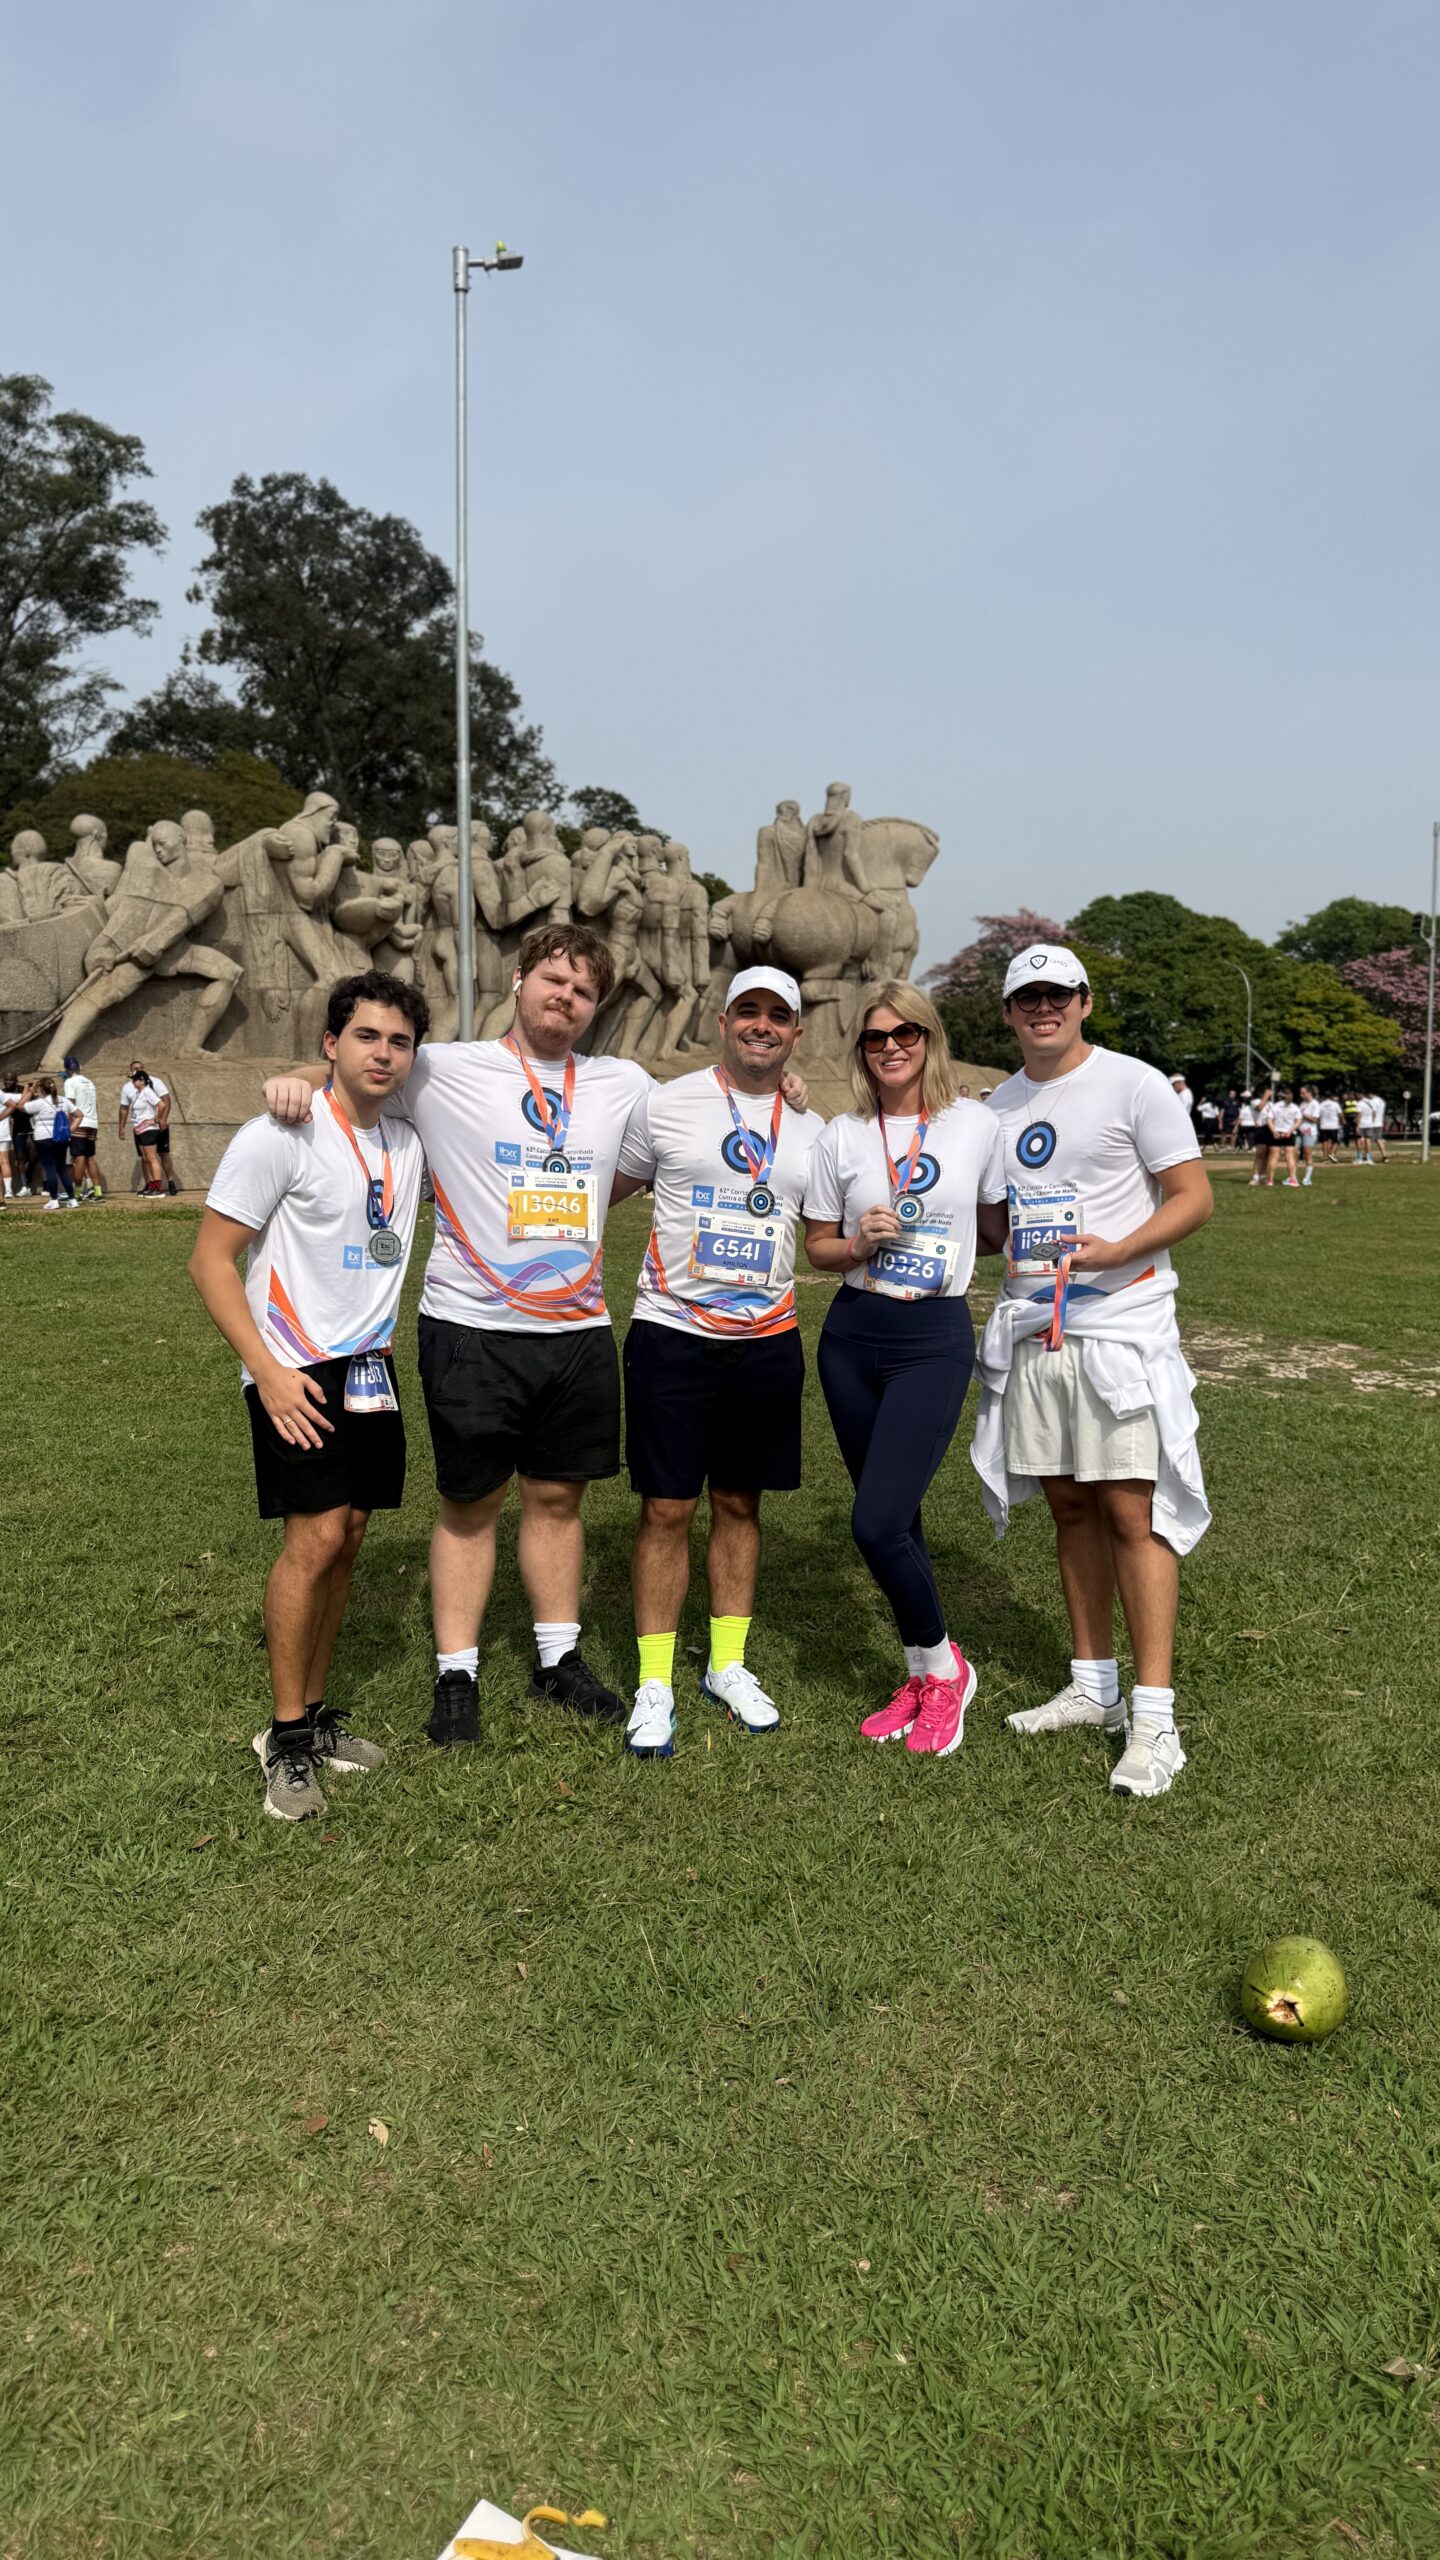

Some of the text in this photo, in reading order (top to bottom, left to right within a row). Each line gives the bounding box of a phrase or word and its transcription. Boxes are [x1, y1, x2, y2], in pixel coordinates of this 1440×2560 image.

[522, 1194, 581, 1214] 13046
[712, 1238, 760, 1261] 6541
[1021, 1229, 1061, 1250] 11941
[722, 1260, 748, 1268] AMILTON
[876, 1251, 935, 1279] 10326
